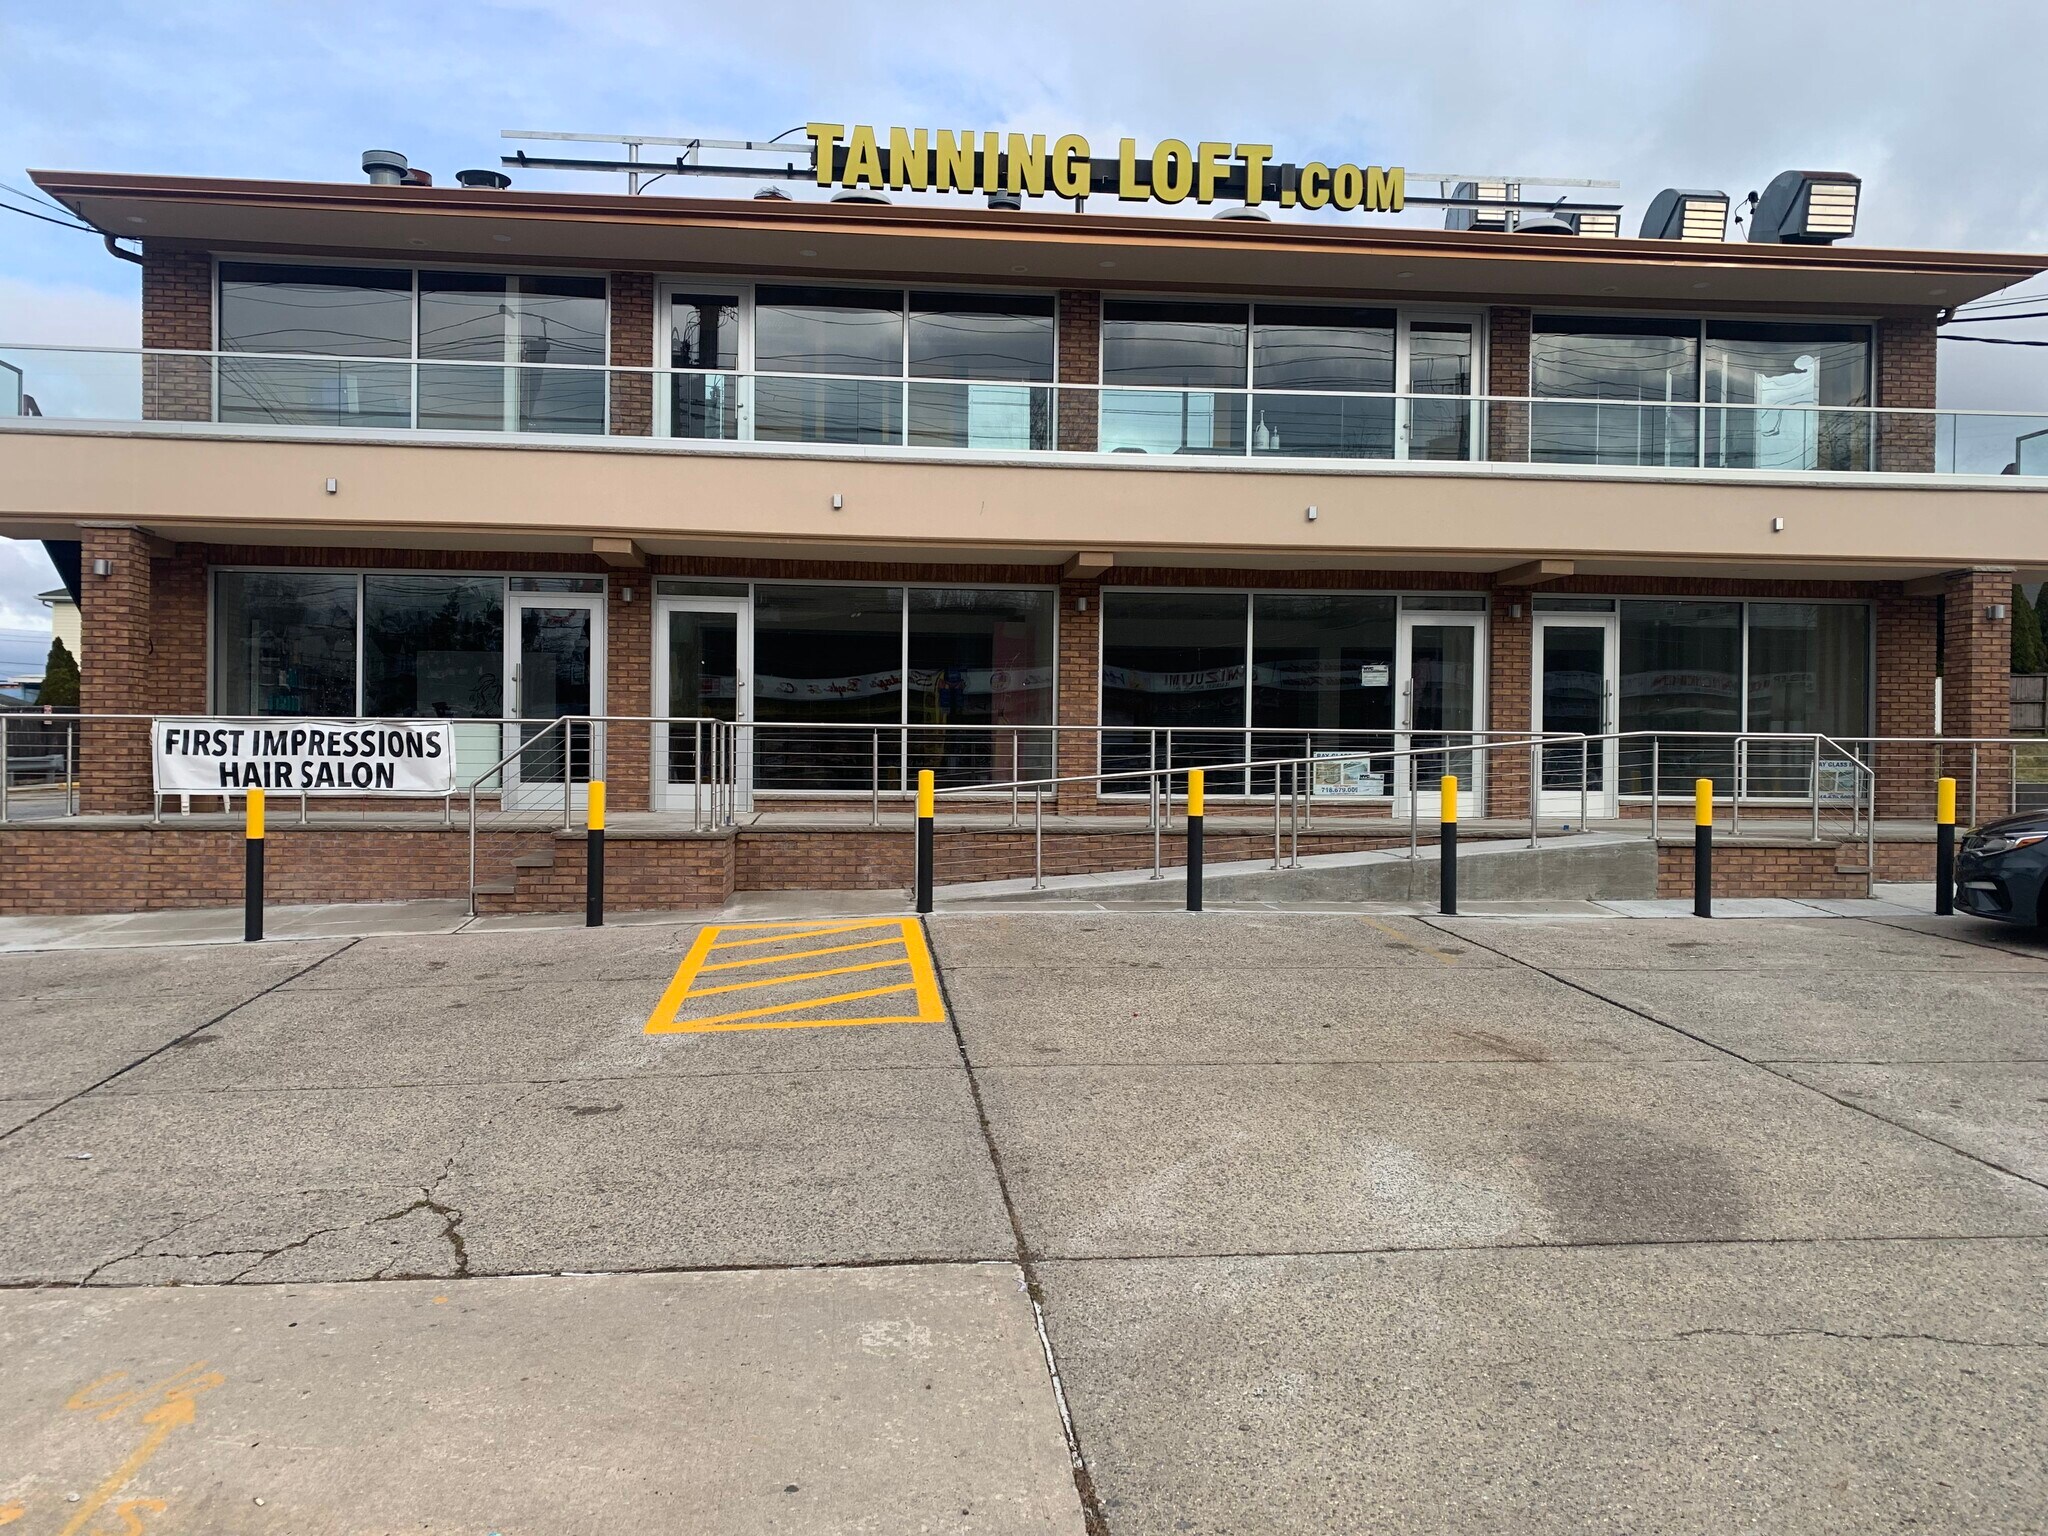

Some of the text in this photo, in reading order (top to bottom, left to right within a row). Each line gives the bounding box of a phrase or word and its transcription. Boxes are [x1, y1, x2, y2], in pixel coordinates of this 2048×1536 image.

[806, 121, 1092, 200] TANNING
[165, 728, 442, 758] FIRST IMPRESSIONS
[219, 760, 395, 788] HAIR SALON
